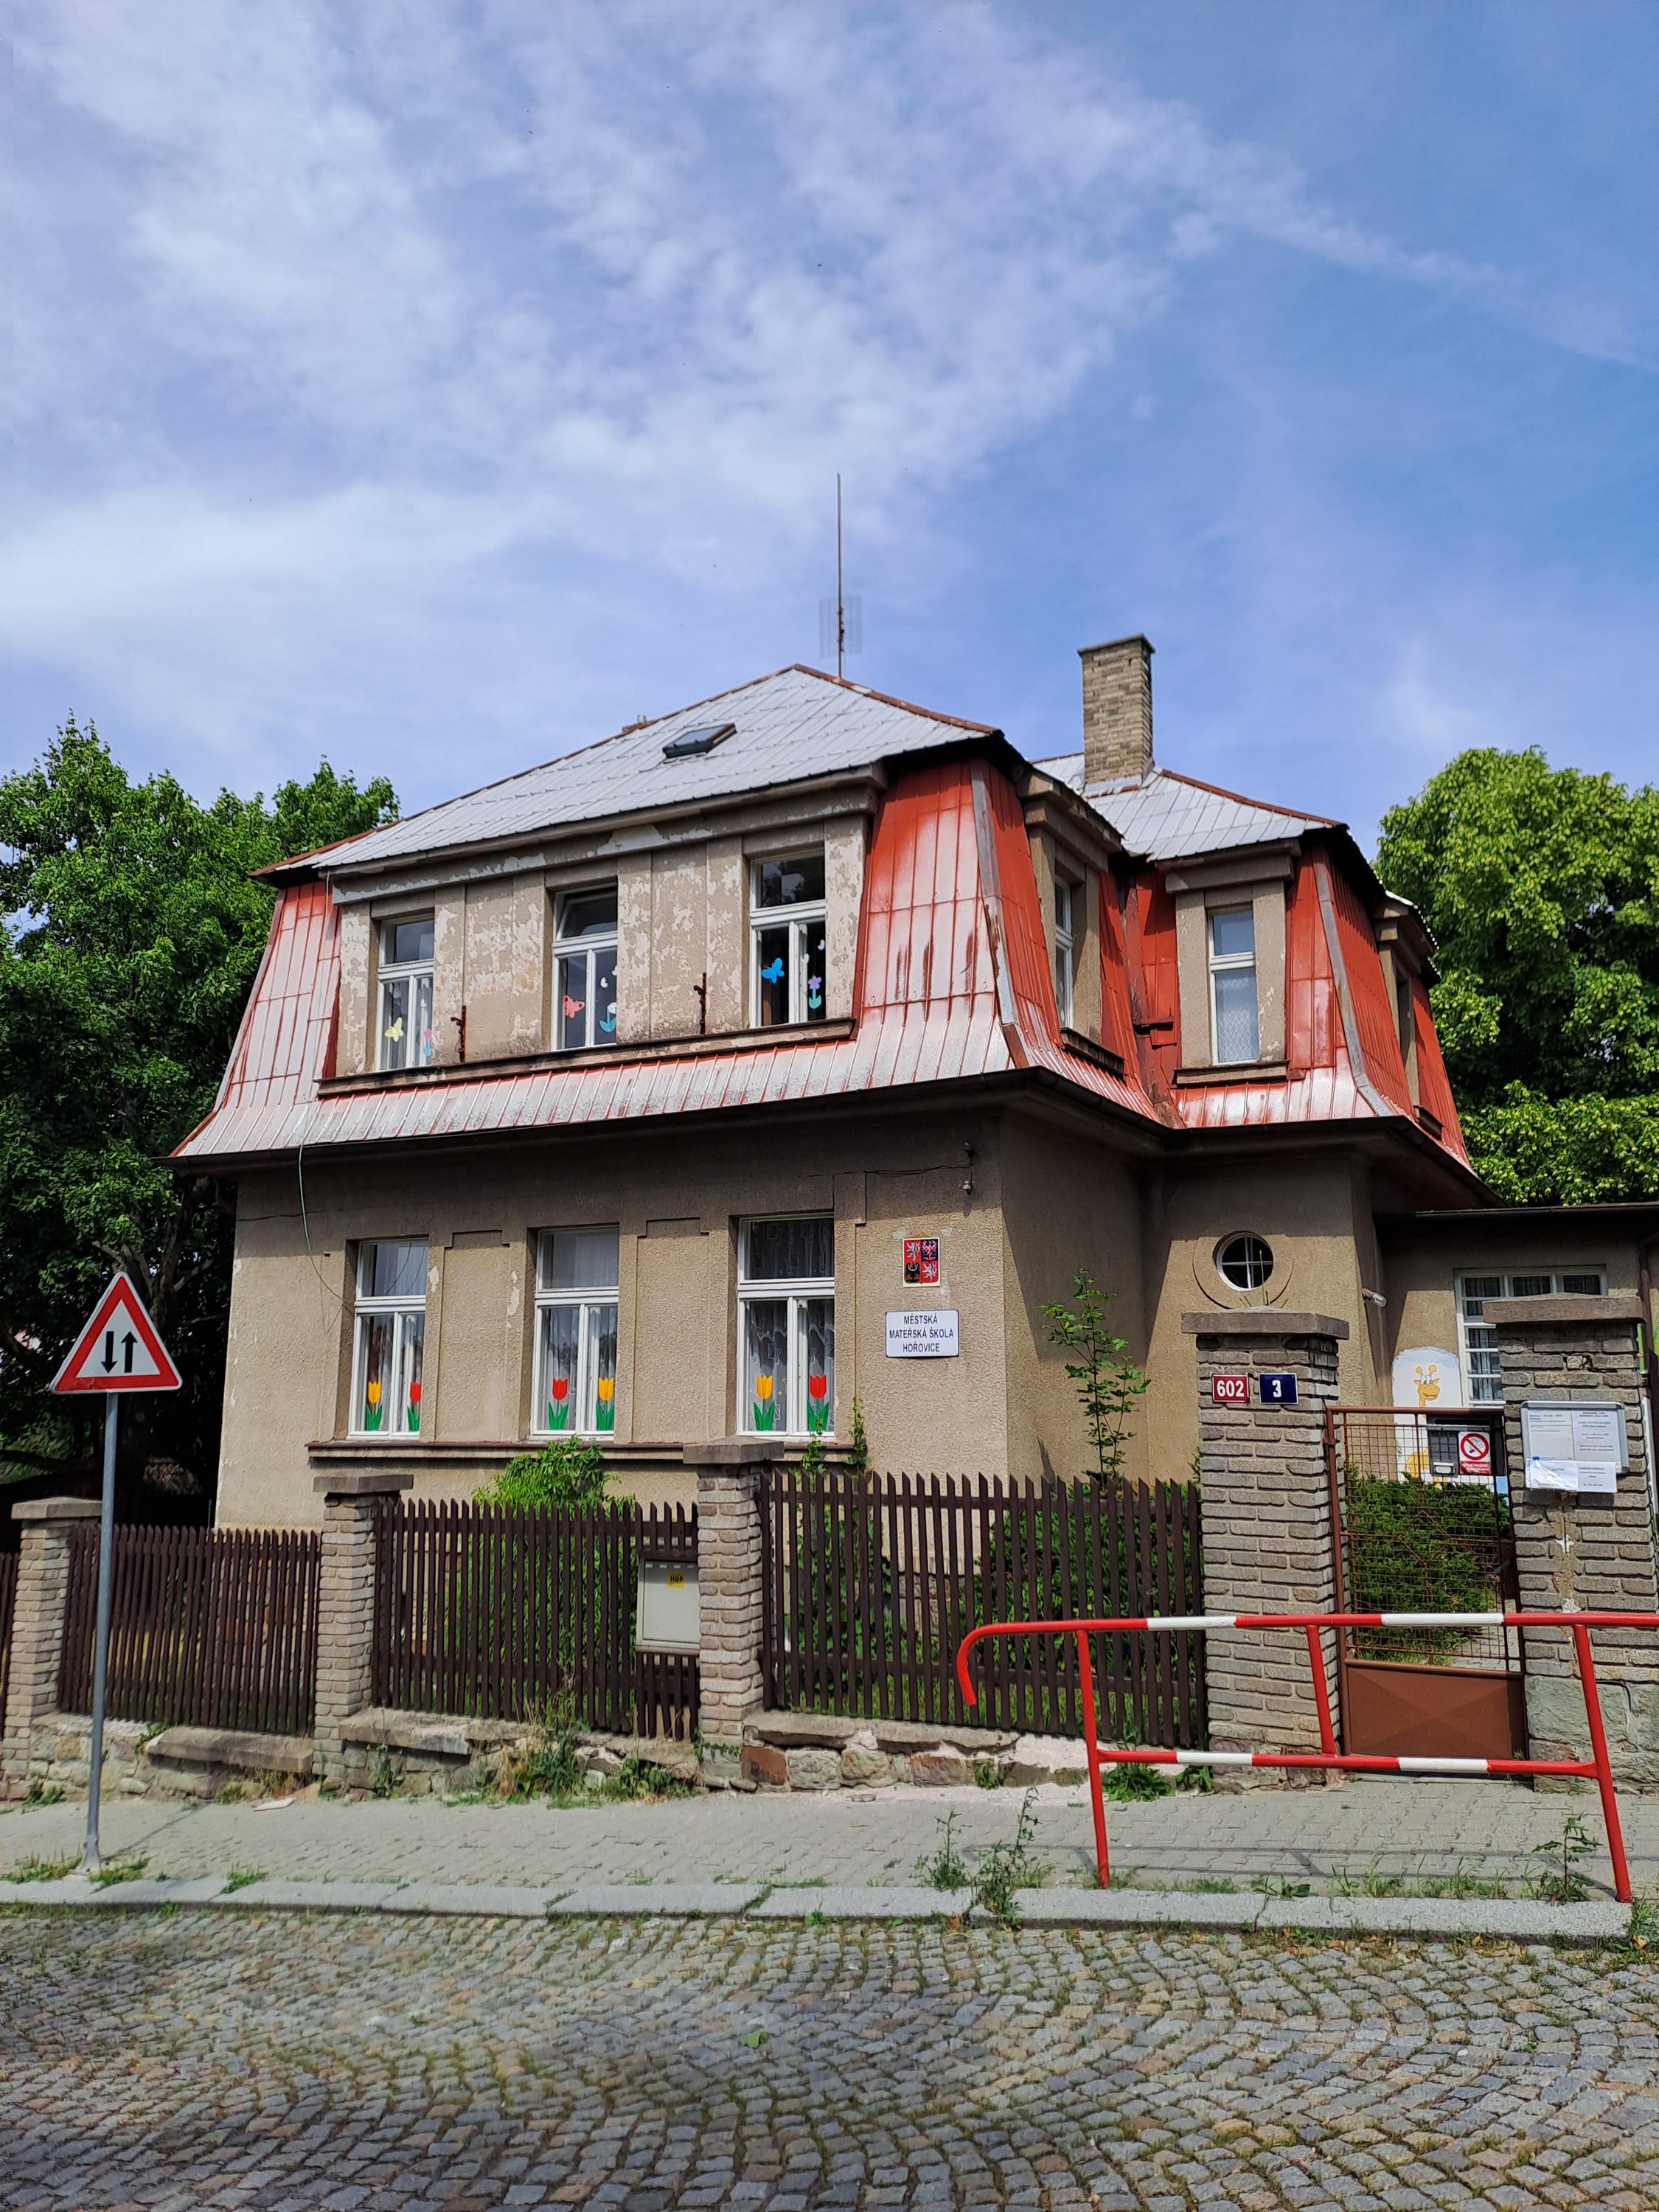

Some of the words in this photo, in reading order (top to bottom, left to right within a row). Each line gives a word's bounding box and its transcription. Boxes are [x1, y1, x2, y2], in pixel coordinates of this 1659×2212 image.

[904, 1312, 938, 1324] MĚSTSKÁ
[889, 1327, 927, 1338] MATEŘSKÁ
[929, 1327, 953, 1338] ŠKOLA
[902, 1341, 940, 1352] HOŘOVICE
[1217, 1380, 1245, 1397] 602
[1272, 1380, 1282, 1398] 3
[669, 1575, 684, 1583] HUP
